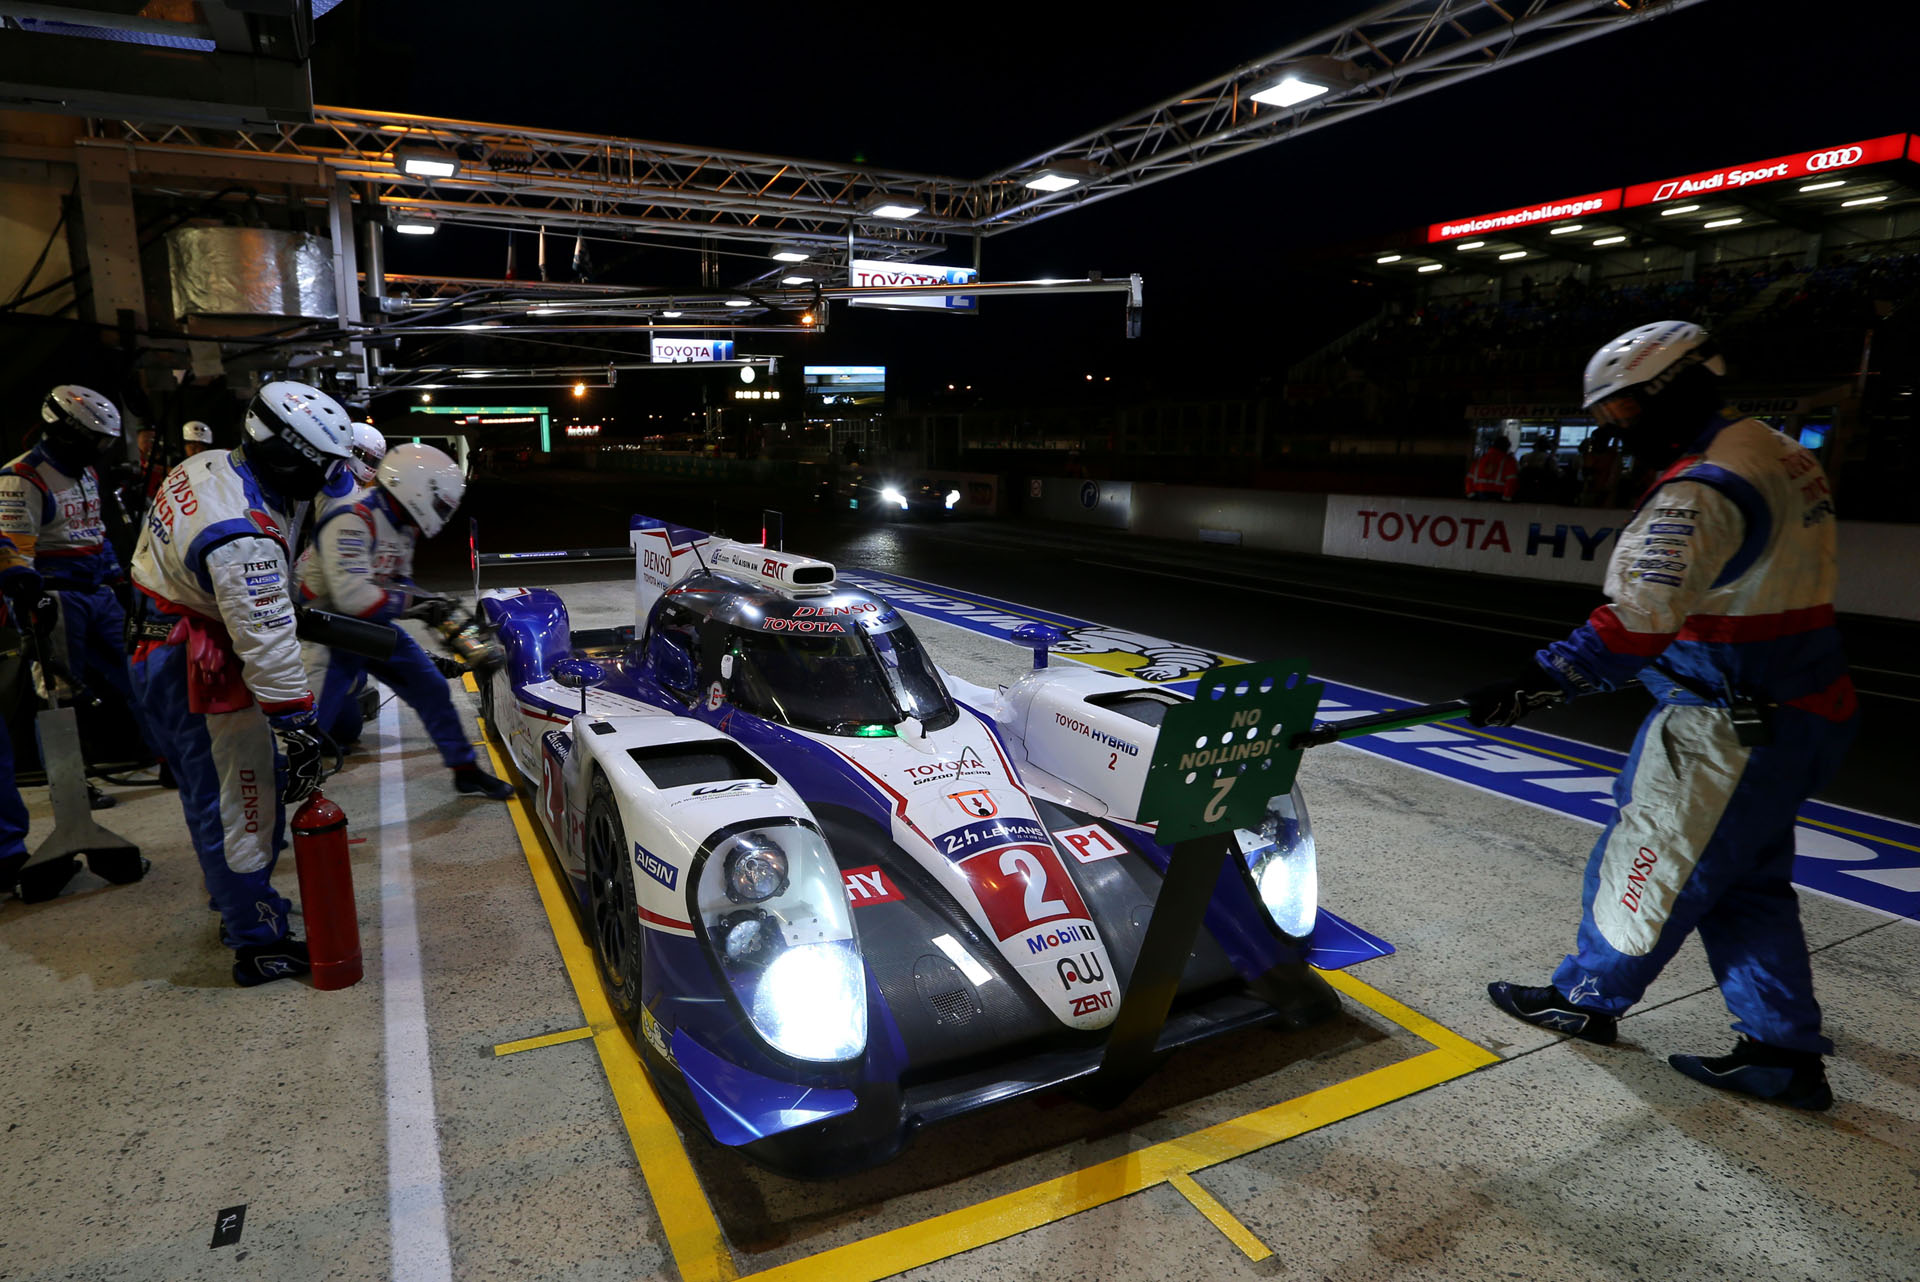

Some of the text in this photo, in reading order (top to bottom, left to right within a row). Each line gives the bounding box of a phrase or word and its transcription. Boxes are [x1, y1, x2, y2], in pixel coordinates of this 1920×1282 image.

[1678, 160, 1789, 193] Audi Sport
[1440, 198, 1603, 237] #welcomechallenges
[952, 270, 971, 306] 2
[655, 342, 727, 360] TOYOTA 1
[1472, 407, 1528, 417] TOYOTA
[280, 426, 327, 468] uvex
[1357, 510, 1622, 562] TOYOTA HY
[243, 559, 279, 574] JTEKT
[643, 549, 671, 578] DENSO
[761, 558, 789, 581] ZENT
[254, 594, 280, 607] ZENT
[792, 602, 878, 617] DENSO
[762, 616, 847, 633] TOYOTA
[1231, 707, 1262, 729] ON
[1055, 711, 1139, 757] TOYOTA HYBRID
[903, 759, 985, 779] TOYOTA
[1108, 752, 1118, 771] 2
[1178, 738, 1273, 771] IGNITION
[913, 773, 953, 786] GAZOO
[239, 769, 259, 834] DENSO
[1202, 776, 1238, 823] 2
[1071, 829, 1117, 858] P1
[636, 846, 676, 886] AISIN
[1620, 845, 1660, 914] DENSO
[845, 871, 889, 900] HY
[998, 848, 1070, 922] 2
[1026, 925, 1081, 955] Mobil
[1069, 989, 1114, 1017] ZENT
